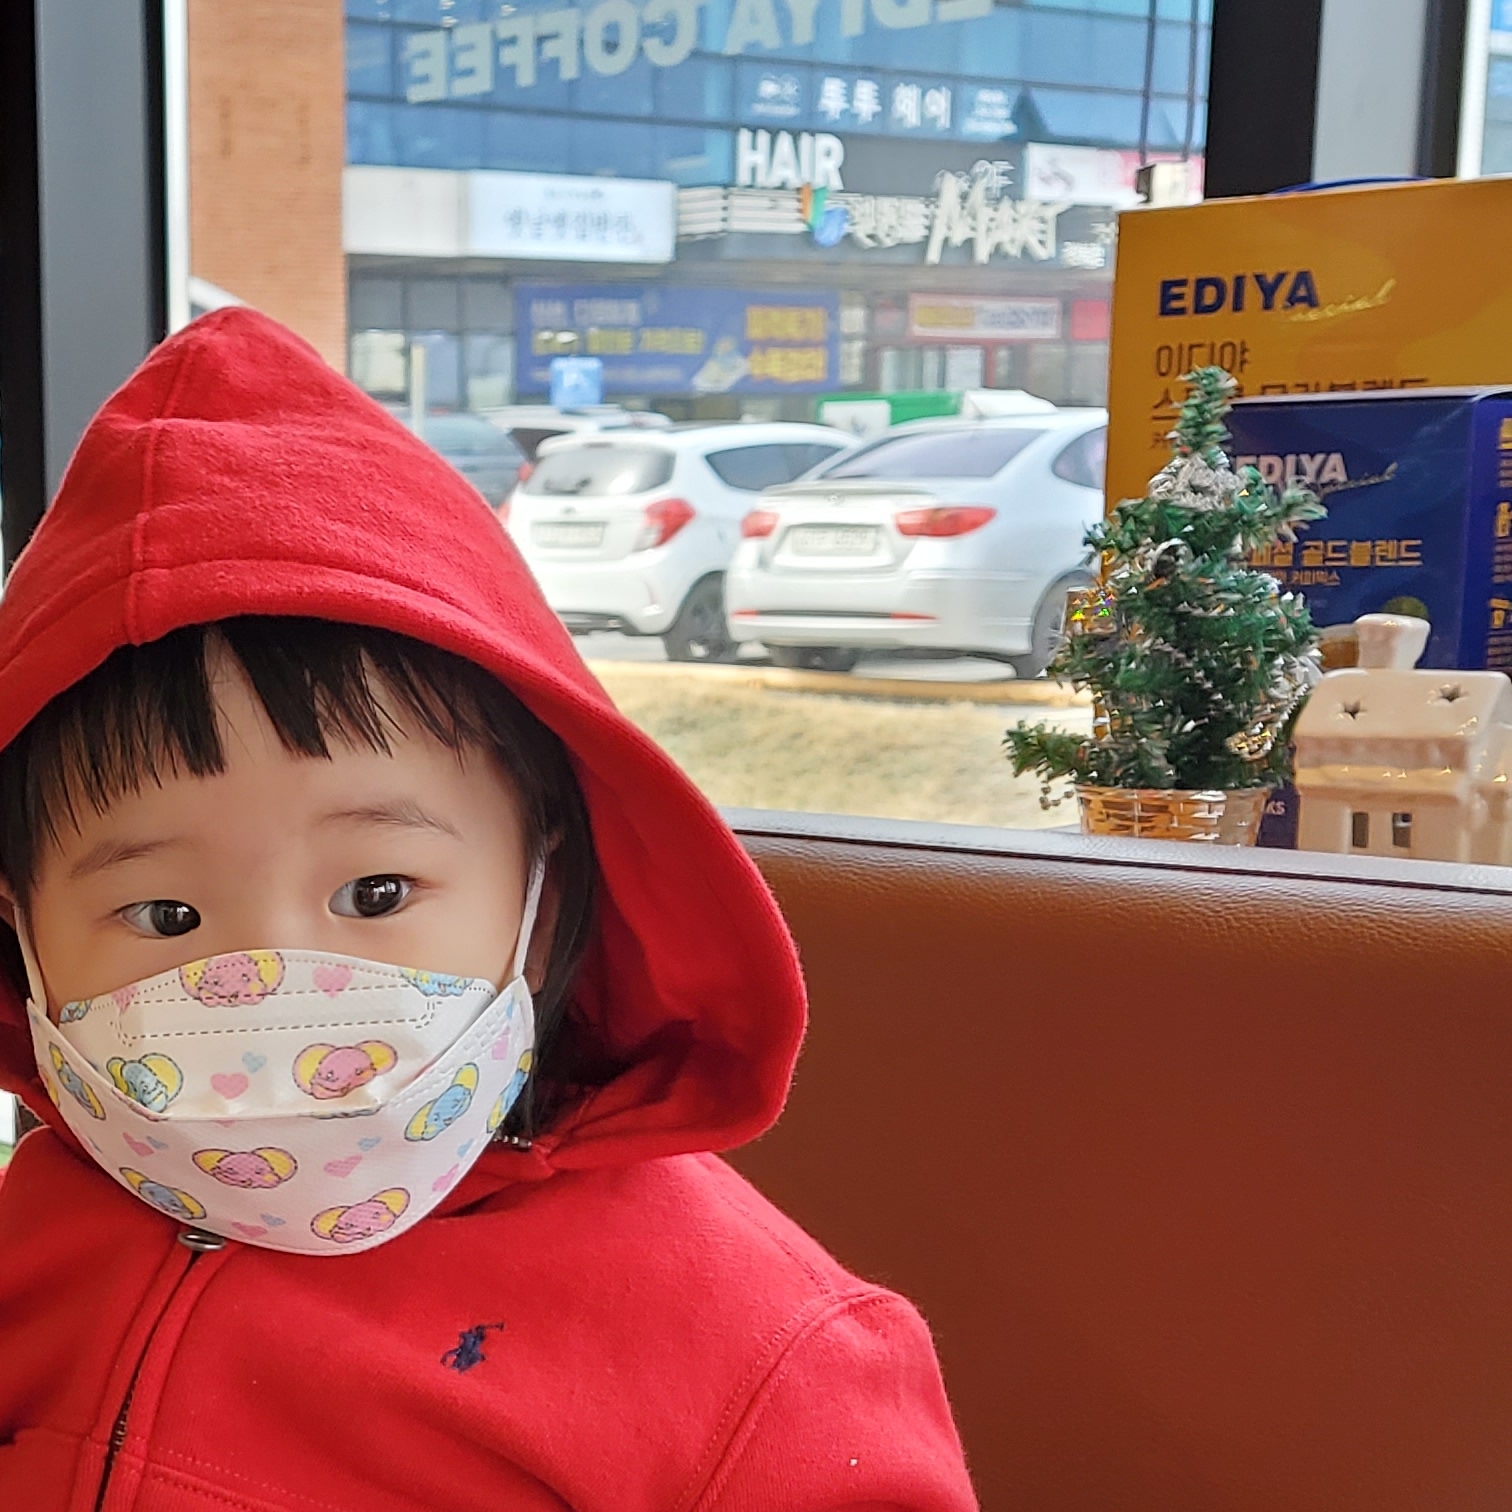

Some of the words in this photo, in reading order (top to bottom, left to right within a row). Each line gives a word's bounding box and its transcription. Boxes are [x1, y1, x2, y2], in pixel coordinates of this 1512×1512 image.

[736, 127, 845, 190] HAIR
[1158, 270, 1320, 317] EDIYA
[1155, 339, 1251, 377] 이디야
[1301, 538, 1424, 567] 골드블렌드
